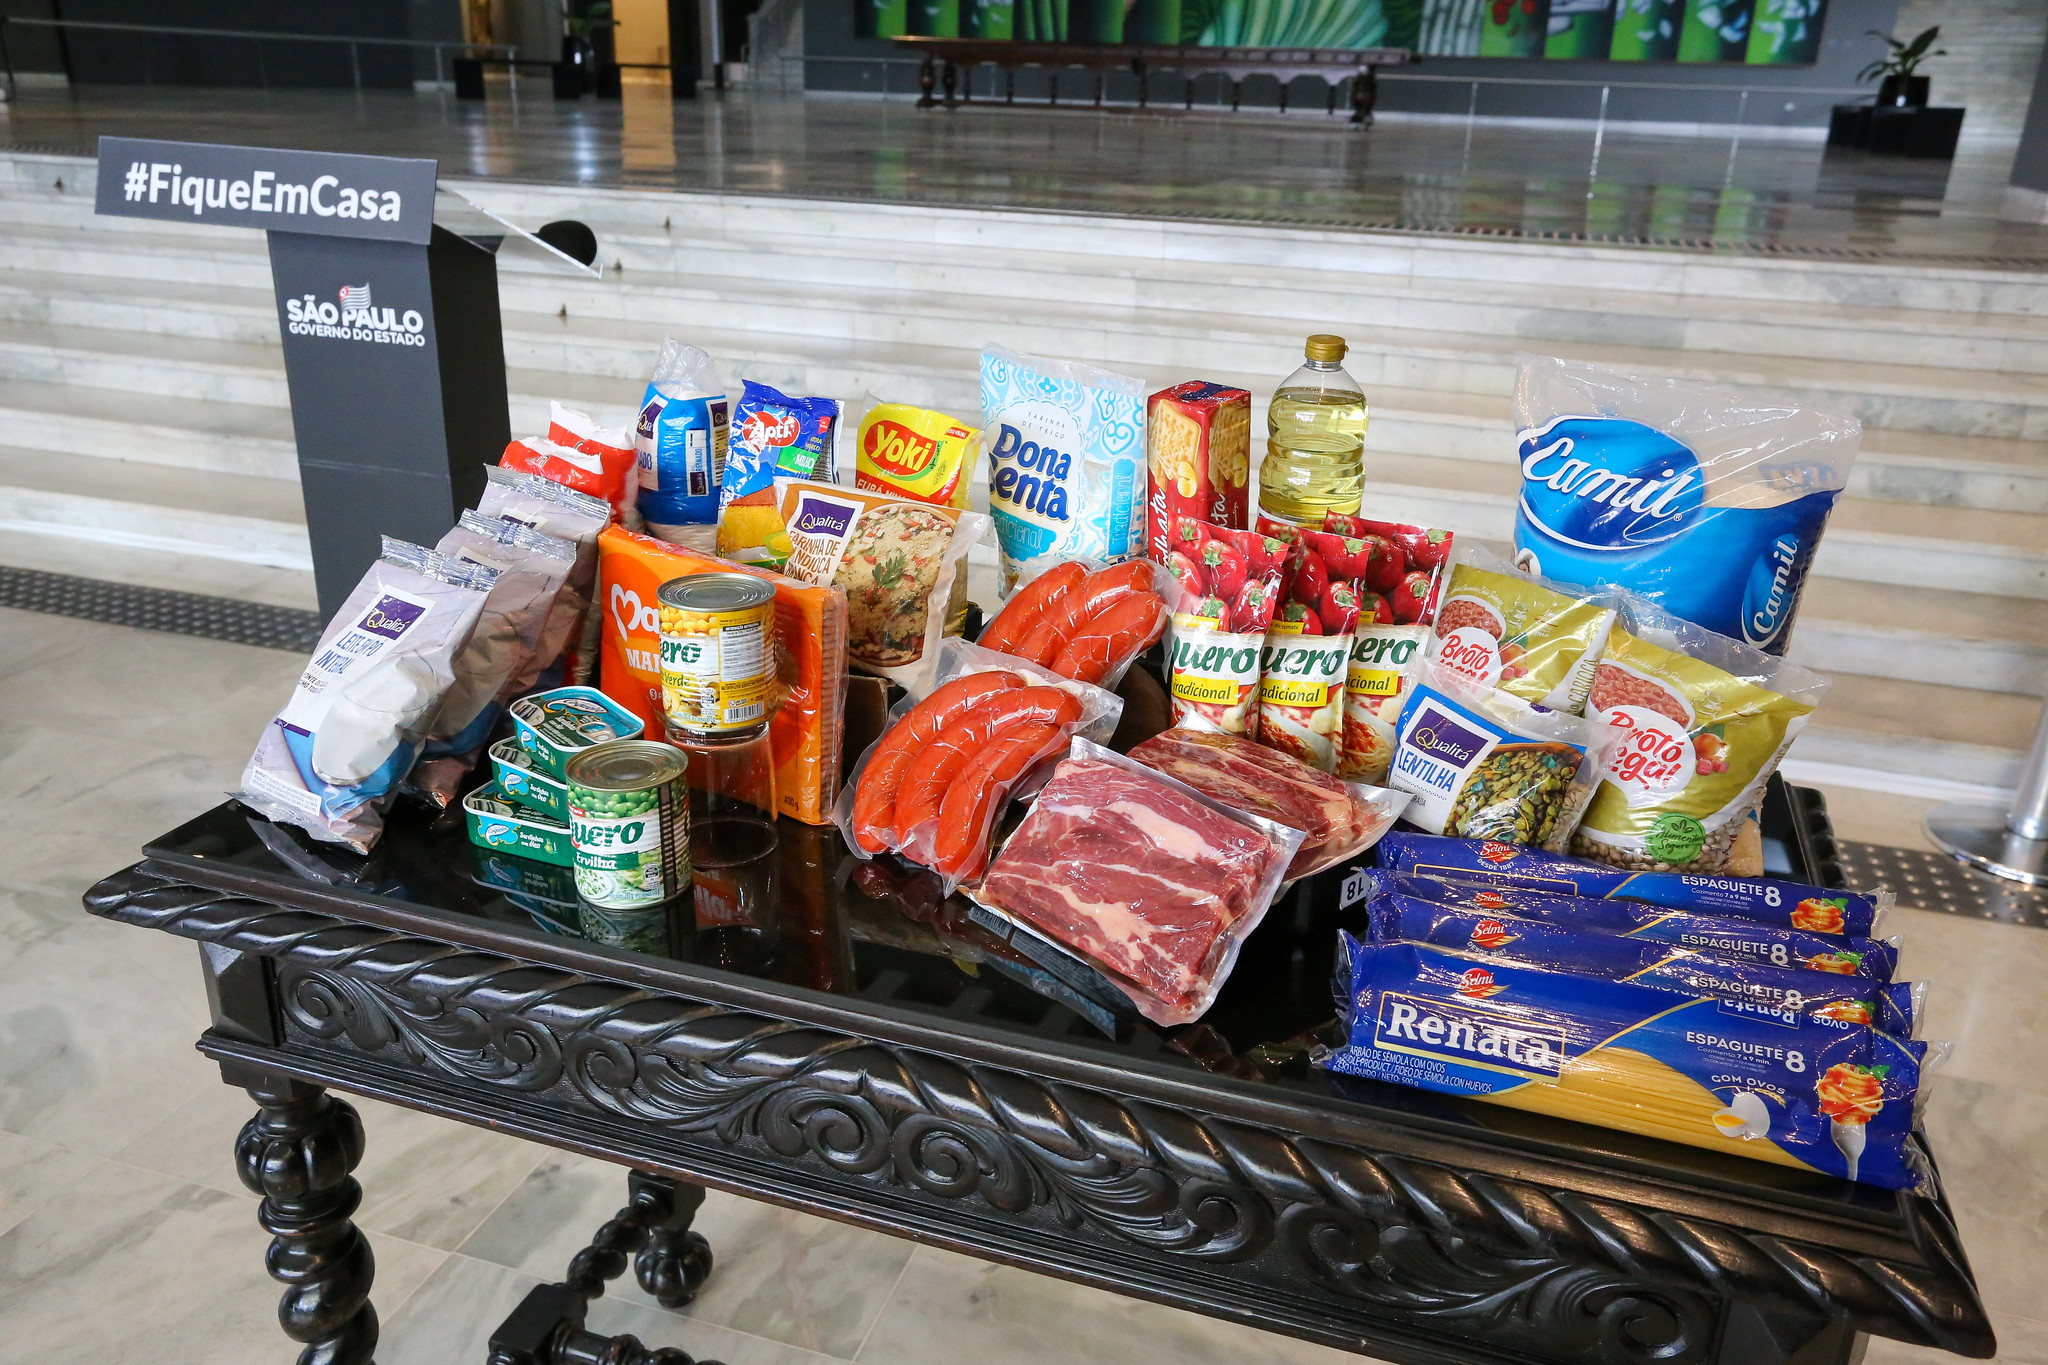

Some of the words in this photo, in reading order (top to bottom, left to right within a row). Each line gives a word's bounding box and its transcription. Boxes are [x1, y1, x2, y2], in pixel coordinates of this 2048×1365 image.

[124, 162, 402, 222] #FiqueEmCasa
[287, 294, 339, 326] SÃO
[342, 306, 424, 333] PAULO
[289, 322, 351, 340] GOVERNO
[353, 328, 373, 341] DO
[374, 330, 426, 347] ESTADO
[1022, 420, 1032, 429] DE
[1038, 426, 1066, 440] TRIGO
[1028, 411, 1066, 428] FARINHA
[871, 424, 932, 472] Yoki
[993, 423, 1072, 482] Dona
[1522, 437, 1696, 519] Camil
[801, 512, 846, 531] Qualitá
[1111, 475, 1132, 545] Tradicional
[824, 539, 841, 557] DE
[1753, 540, 1799, 634] Camil
[366, 610, 411, 633] Qualitá
[1261, 646, 1347, 676] uero
[1568, 659, 1600, 703] CARIOCA
[1415, 727, 1474, 761] Qualitá
[1398, 748, 1457, 792] LENTILHA
[1480, 843, 1511, 856] Selmi
[1476, 858, 1498, 871] DESDE
[1681, 875, 1764, 896] ESPAGUETE
[1764, 885, 1782, 908] 8
[1691, 887, 1724, 898] Cozimento
[1470, 922, 1506, 938] Selmi
[1681, 933, 1768, 955] ESPAGUETE
[1770, 943, 1789, 965] 8
[1460, 967, 1495, 989] Selmi
[1785, 989, 1804, 1010] 8
[1385, 1001, 1551, 1068] Renata
[1372, 1049, 1382, 1061] DE
[1409, 1057, 1427, 1068] COM
[1426, 1060, 1446, 1073] OVOS
[1686, 1031, 1784, 1060] ESPAGUETE
[1785, 1050, 1806, 1073] 8
[1697, 1046, 1736, 1058] Cozimento
[1755, 1058, 1772, 1066] min.
[1413, 1068, 1424, 1079] DE
[1465, 1080, 1492, 1094] HUEVOS
[1746, 1077, 1786, 1095] OVOS
